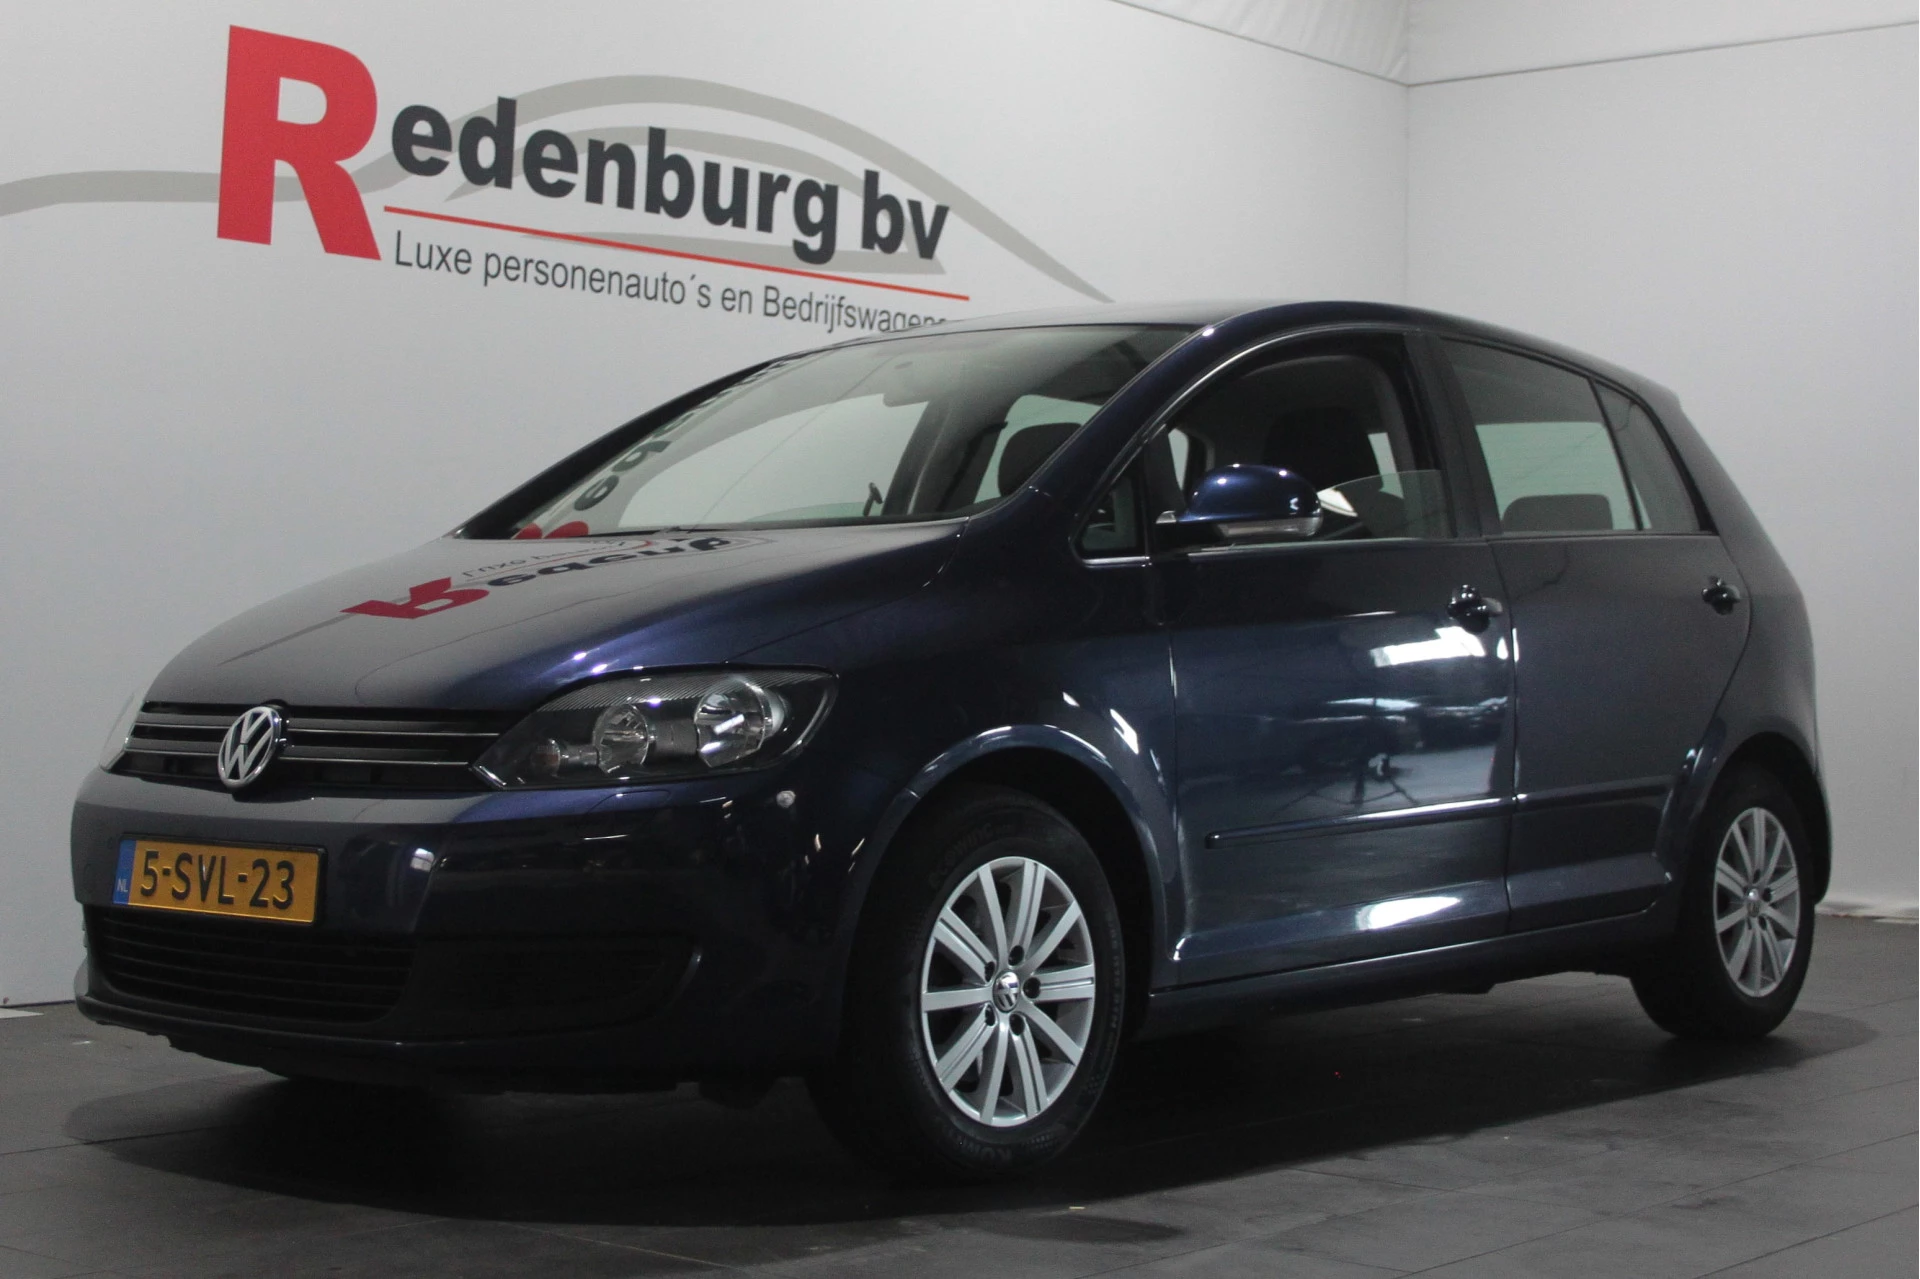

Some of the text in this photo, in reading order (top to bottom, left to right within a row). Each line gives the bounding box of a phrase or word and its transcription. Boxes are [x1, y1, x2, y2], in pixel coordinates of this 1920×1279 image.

[217, 25, 950, 265] Redenburg bv
[394, 230, 472, 275] Luxe
[720, 286, 753, 315] en
[116, 876, 129, 894] NL
[140, 850, 295, 910] 5-SVL-23
